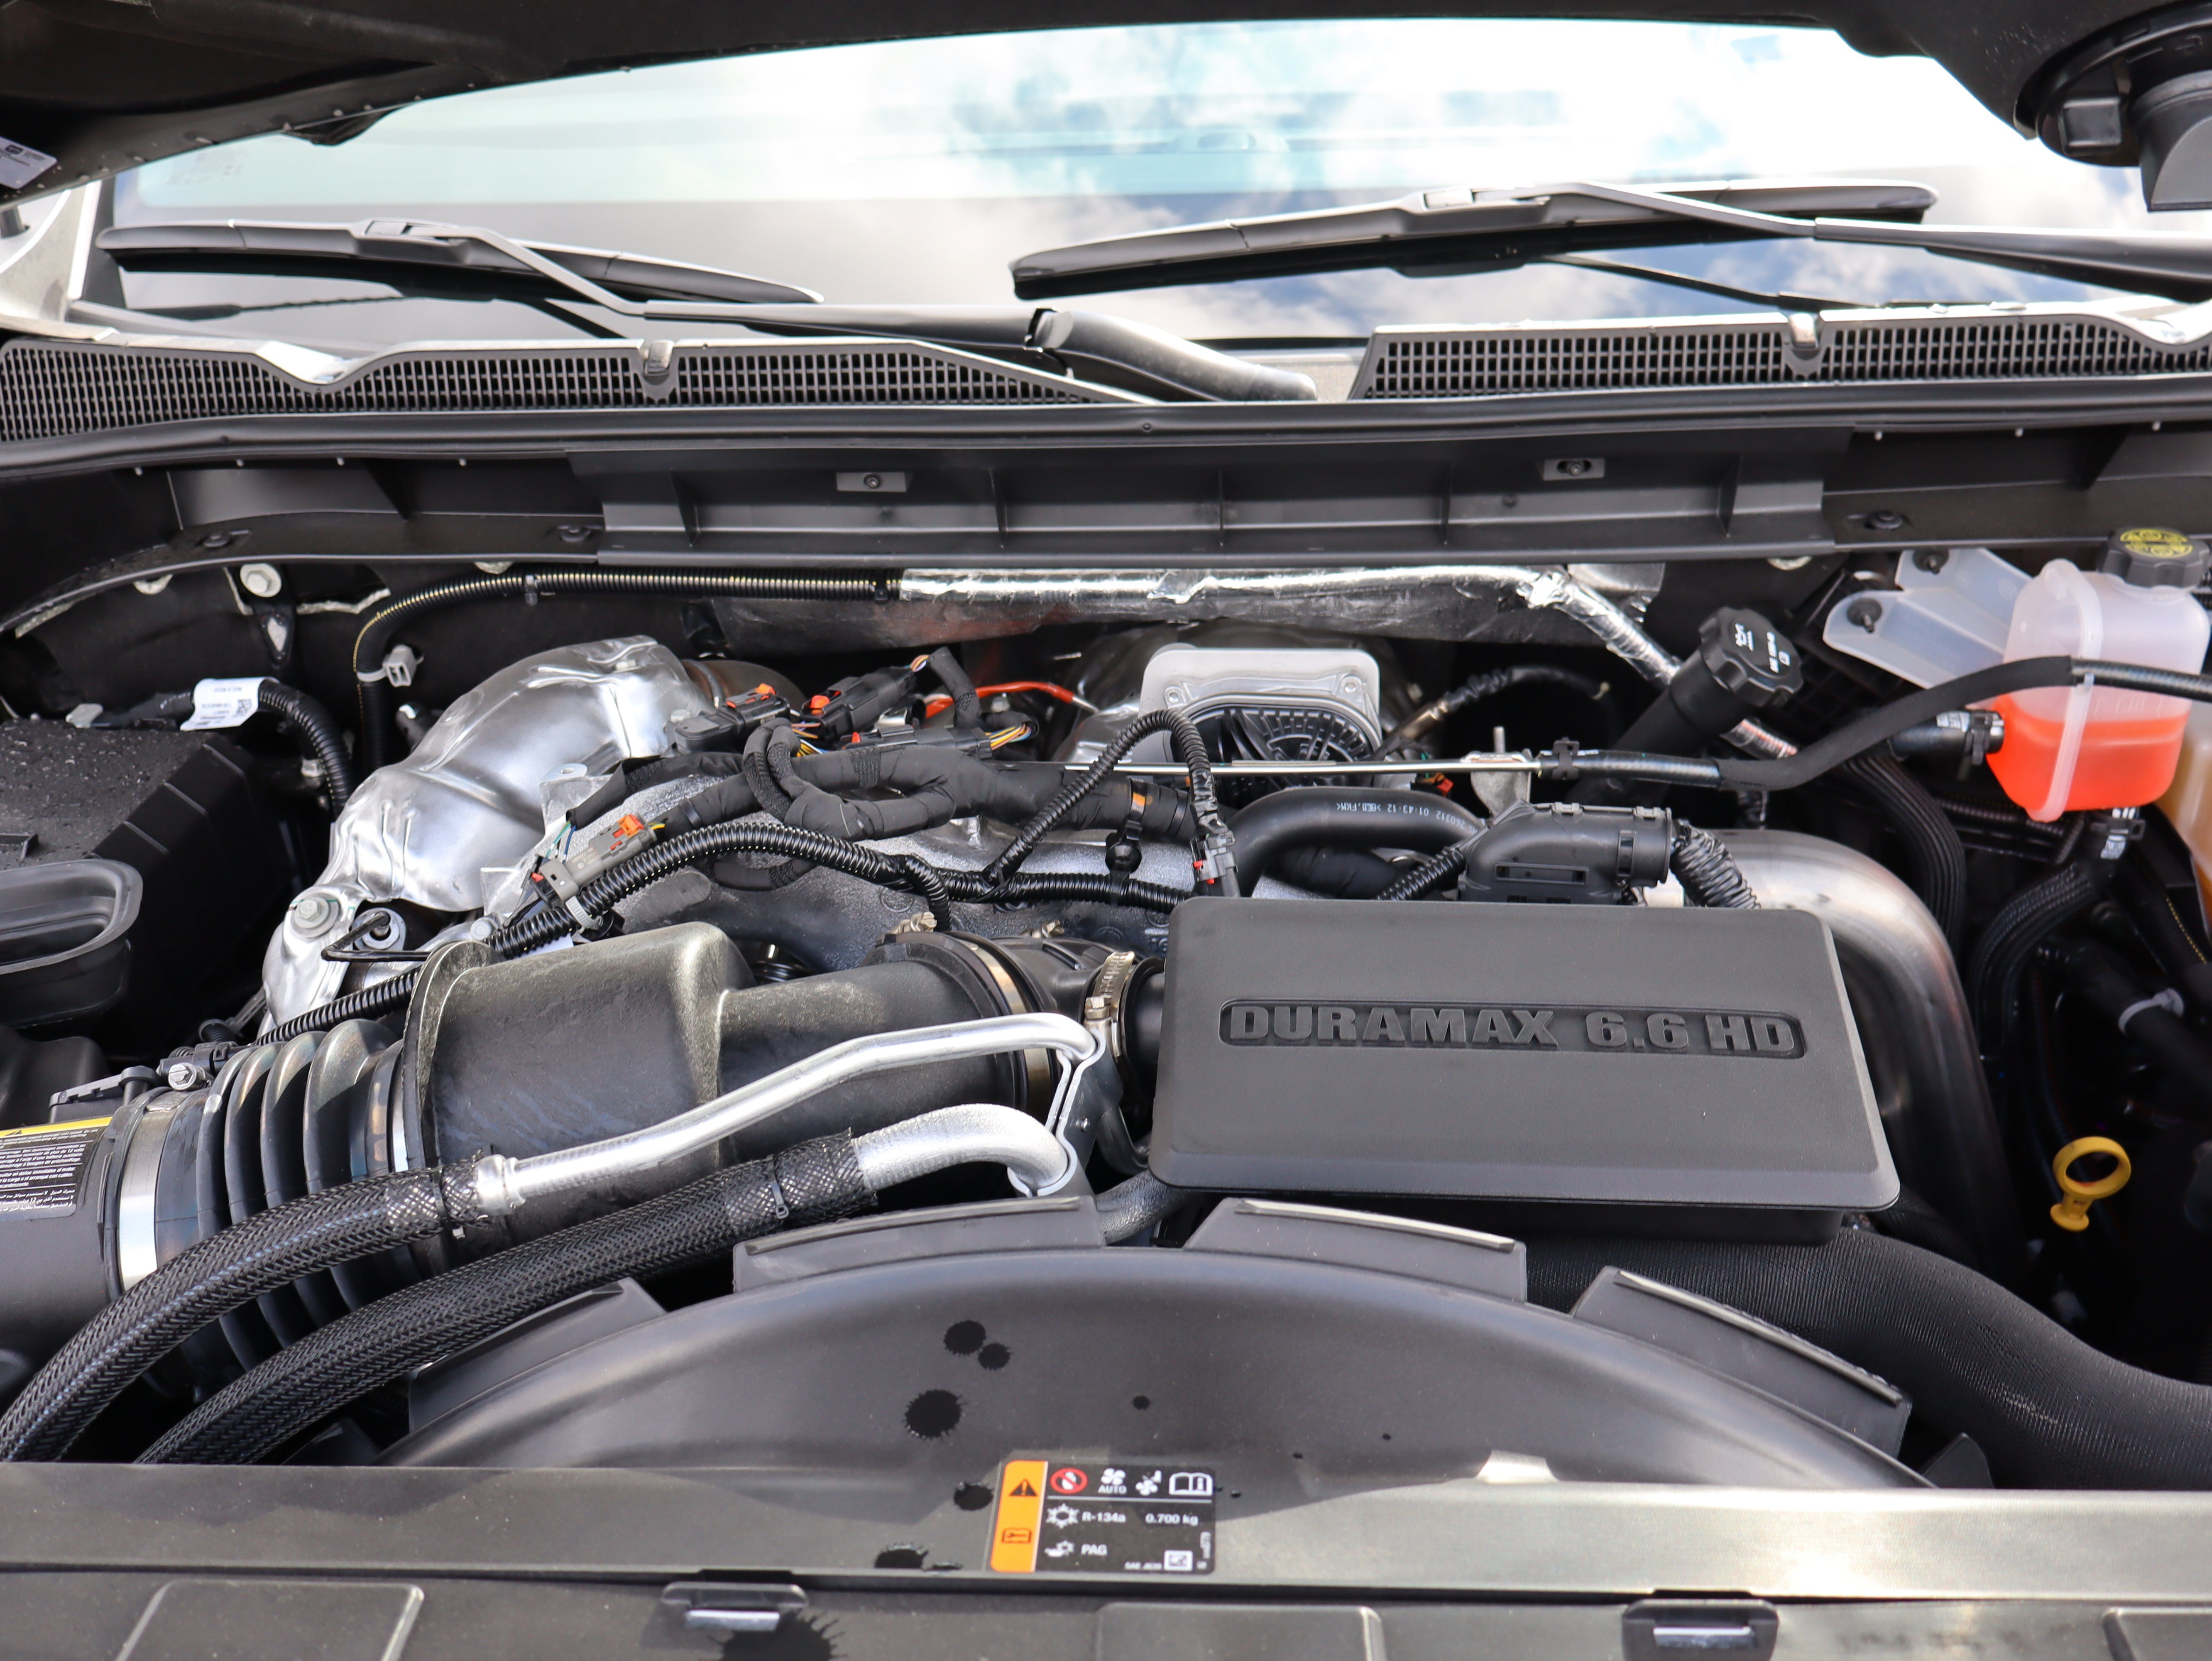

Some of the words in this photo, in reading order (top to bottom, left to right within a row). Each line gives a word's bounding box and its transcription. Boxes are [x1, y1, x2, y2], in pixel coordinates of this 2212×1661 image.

[1436, 811, 1466, 829] 260312
[1229, 1006, 1559, 1047] DURAMAX
[1585, 1010, 1691, 1051] 6.6
[1705, 1013, 1794, 1053] HD
[1098, 1485, 1127, 1494] AUTO
[1082, 1511, 1126, 1523] R-134a
[1145, 1513, 1180, 1524] 0.700
[1182, 1514, 1199, 1526] kg
[1081, 1543, 1107, 1556] PAG
